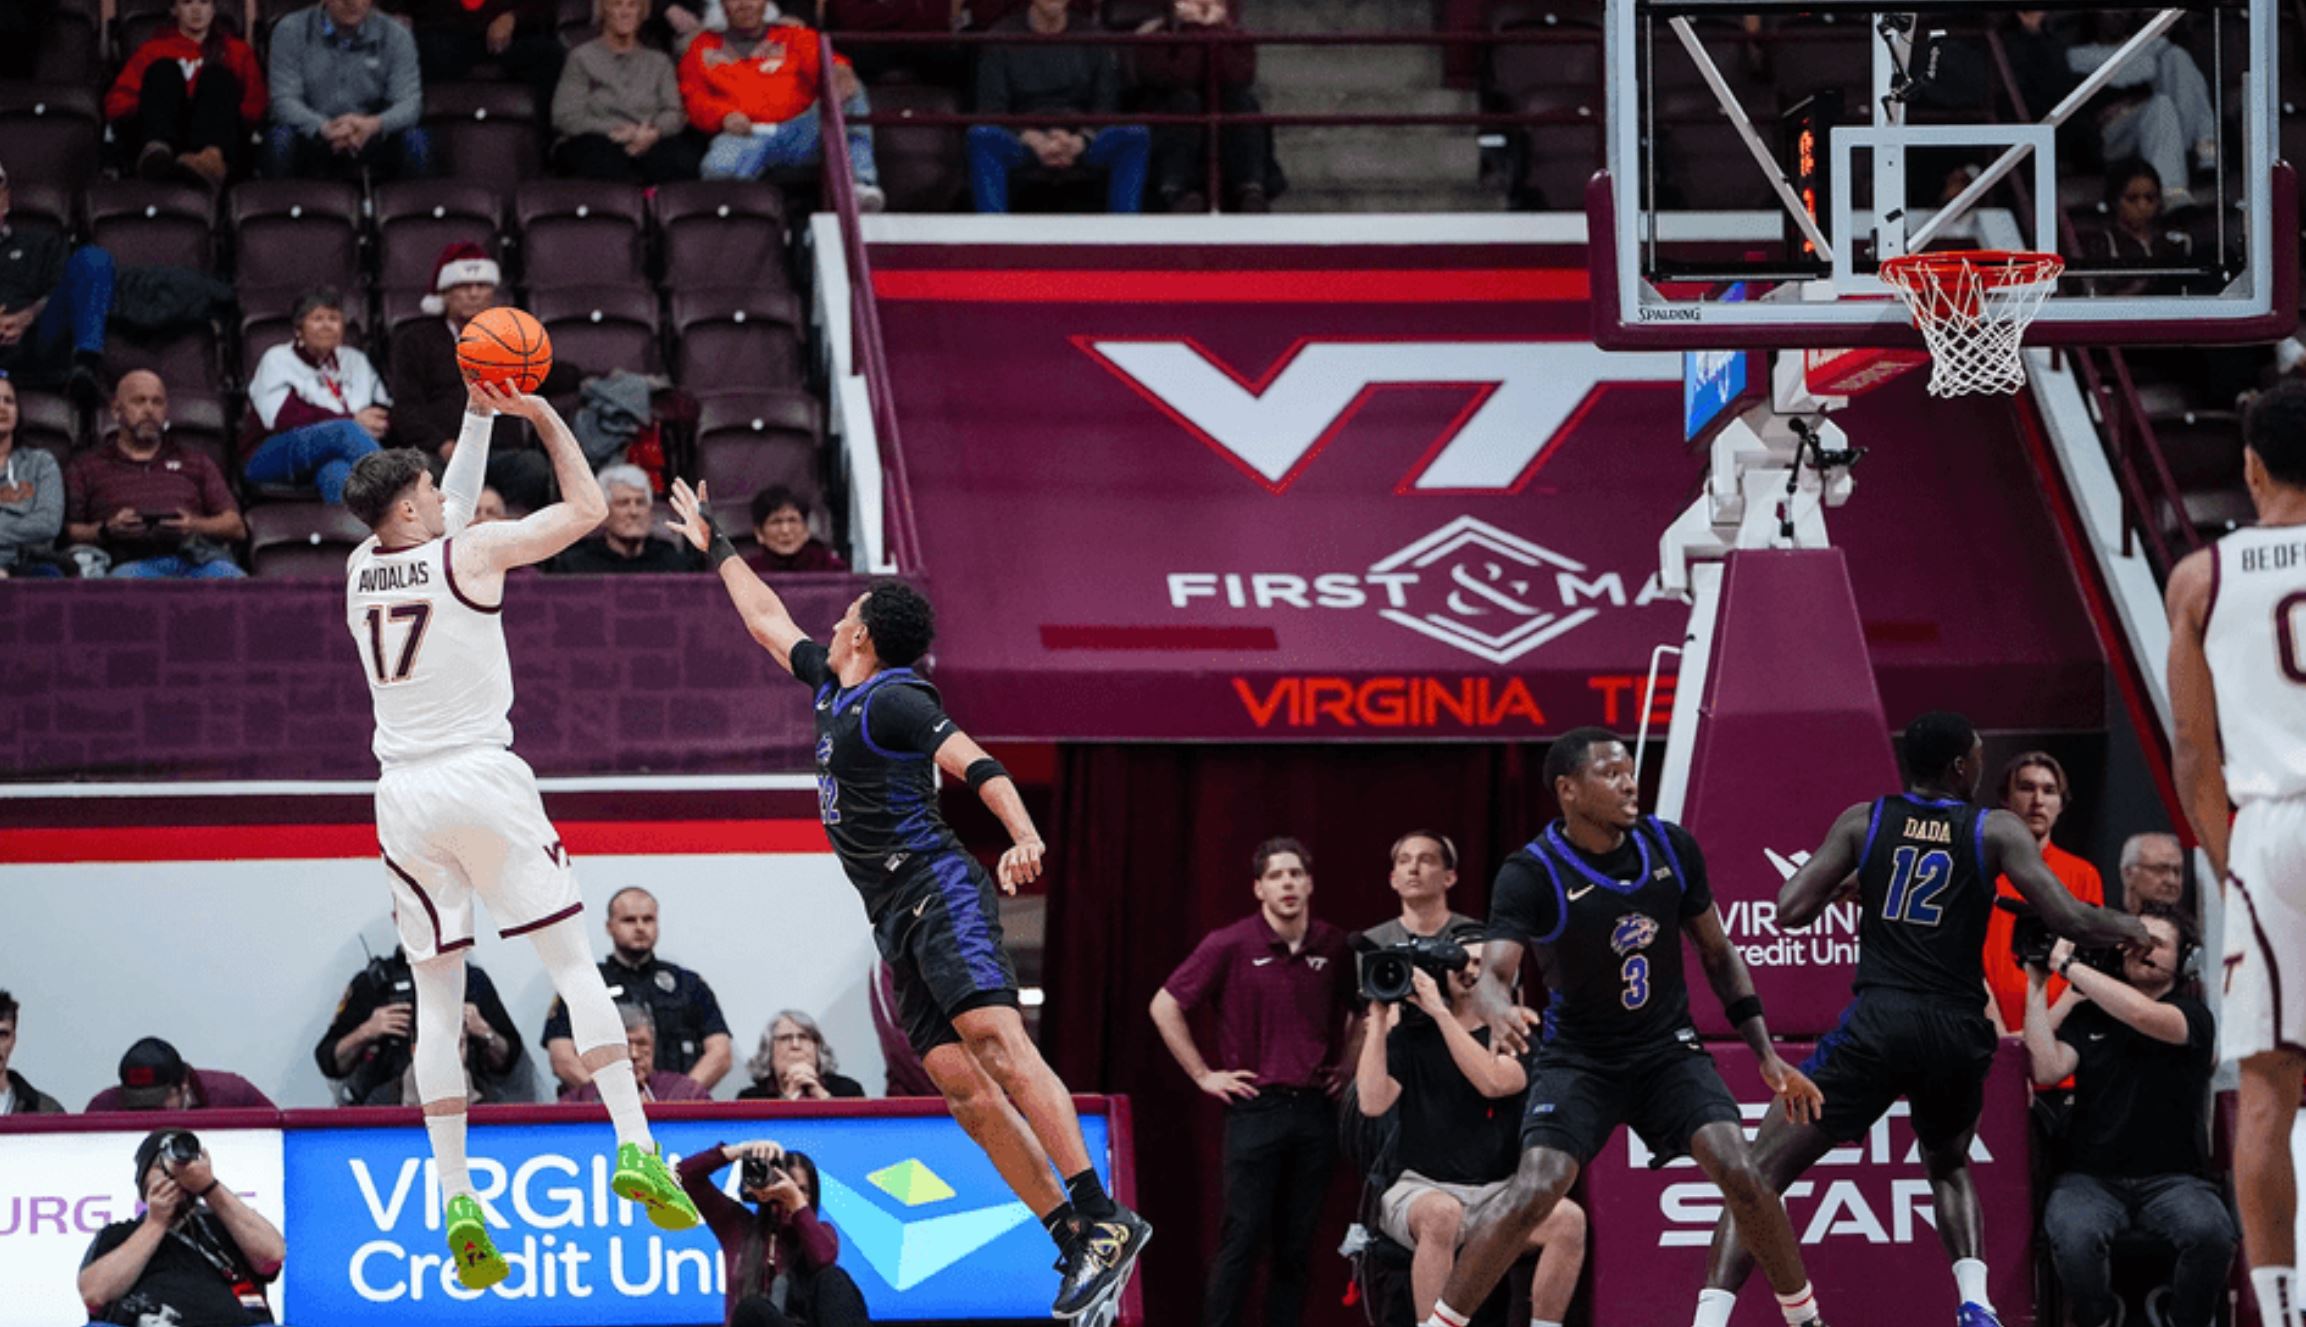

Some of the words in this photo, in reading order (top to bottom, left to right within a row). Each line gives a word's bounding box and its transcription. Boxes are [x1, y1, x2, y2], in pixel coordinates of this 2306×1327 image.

[1638, 307, 1701, 322] SPALDING
[1068, 335, 1684, 495] VT
[2242, 543, 2306, 572] BEDF
[359, 561, 429, 593] AVDALAS
[1167, 573, 1419, 609] FIRST
[1556, 572, 1693, 607] MA
[363, 599, 434, 684] 17
[1232, 676, 1546, 727] VIRGINIA
[1588, 675, 1679, 726] TE
[1903, 816, 1951, 843] DADA
[1881, 845, 1953, 926] 12
[1735, 937, 1806, 966] redit
[1811, 936, 1860, 965] Uni
[1620, 954, 1650, 1010] 3
